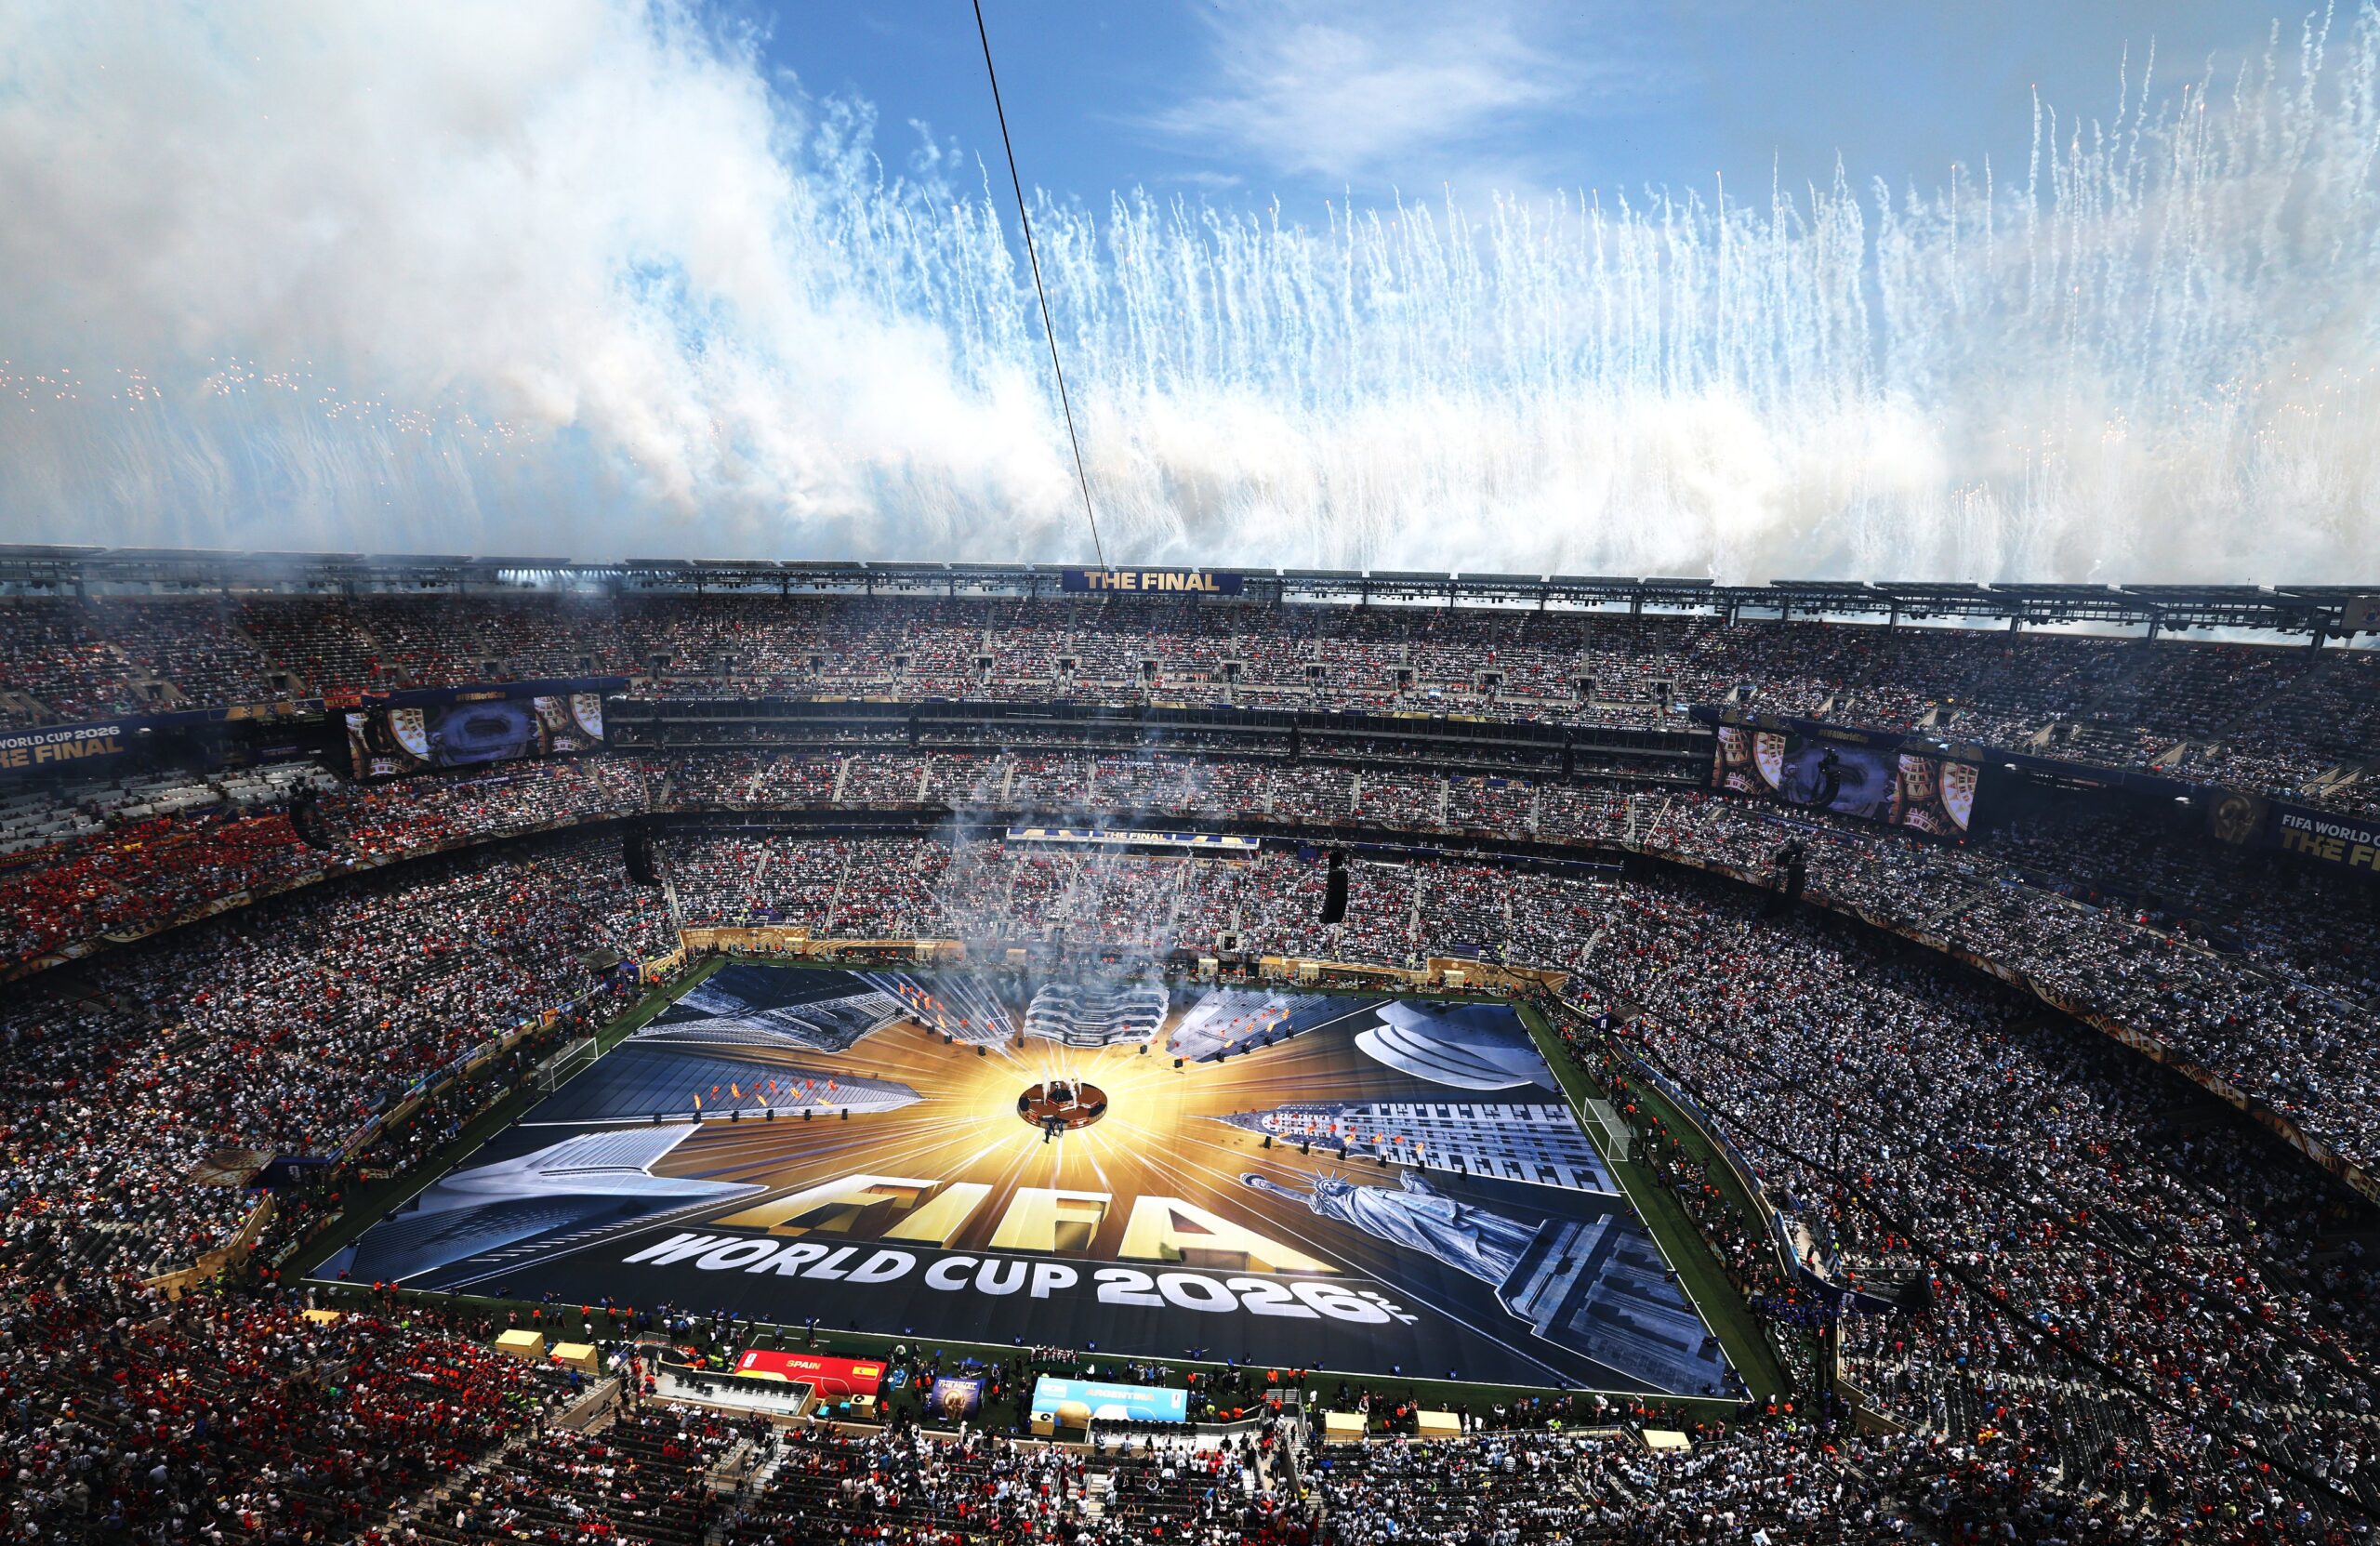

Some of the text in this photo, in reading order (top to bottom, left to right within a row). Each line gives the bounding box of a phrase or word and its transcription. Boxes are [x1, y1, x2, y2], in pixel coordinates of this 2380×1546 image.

[1084, 571, 1221, 591] THE FINAL
[46, 731, 73, 743] CUP
[74, 726, 121, 740] 2026
[34, 736, 125, 764] FINAL
[1129, 832, 1167, 840] FINAL
[2281, 813, 2312, 831] FIFA
[2315, 821, 2372, 844] WORLD
[2280, 826, 2347, 862] THE
[708, 1173, 1344, 1275] FIFA
[621, 1233, 916, 1284] WORLD
[924, 1256, 1078, 1299] CUP
[1093, 1268, 1391, 1324] 2026
[786, 1360, 822, 1370] SPAIN
[1086, 1388, 1155, 1401] ARGENTINA
